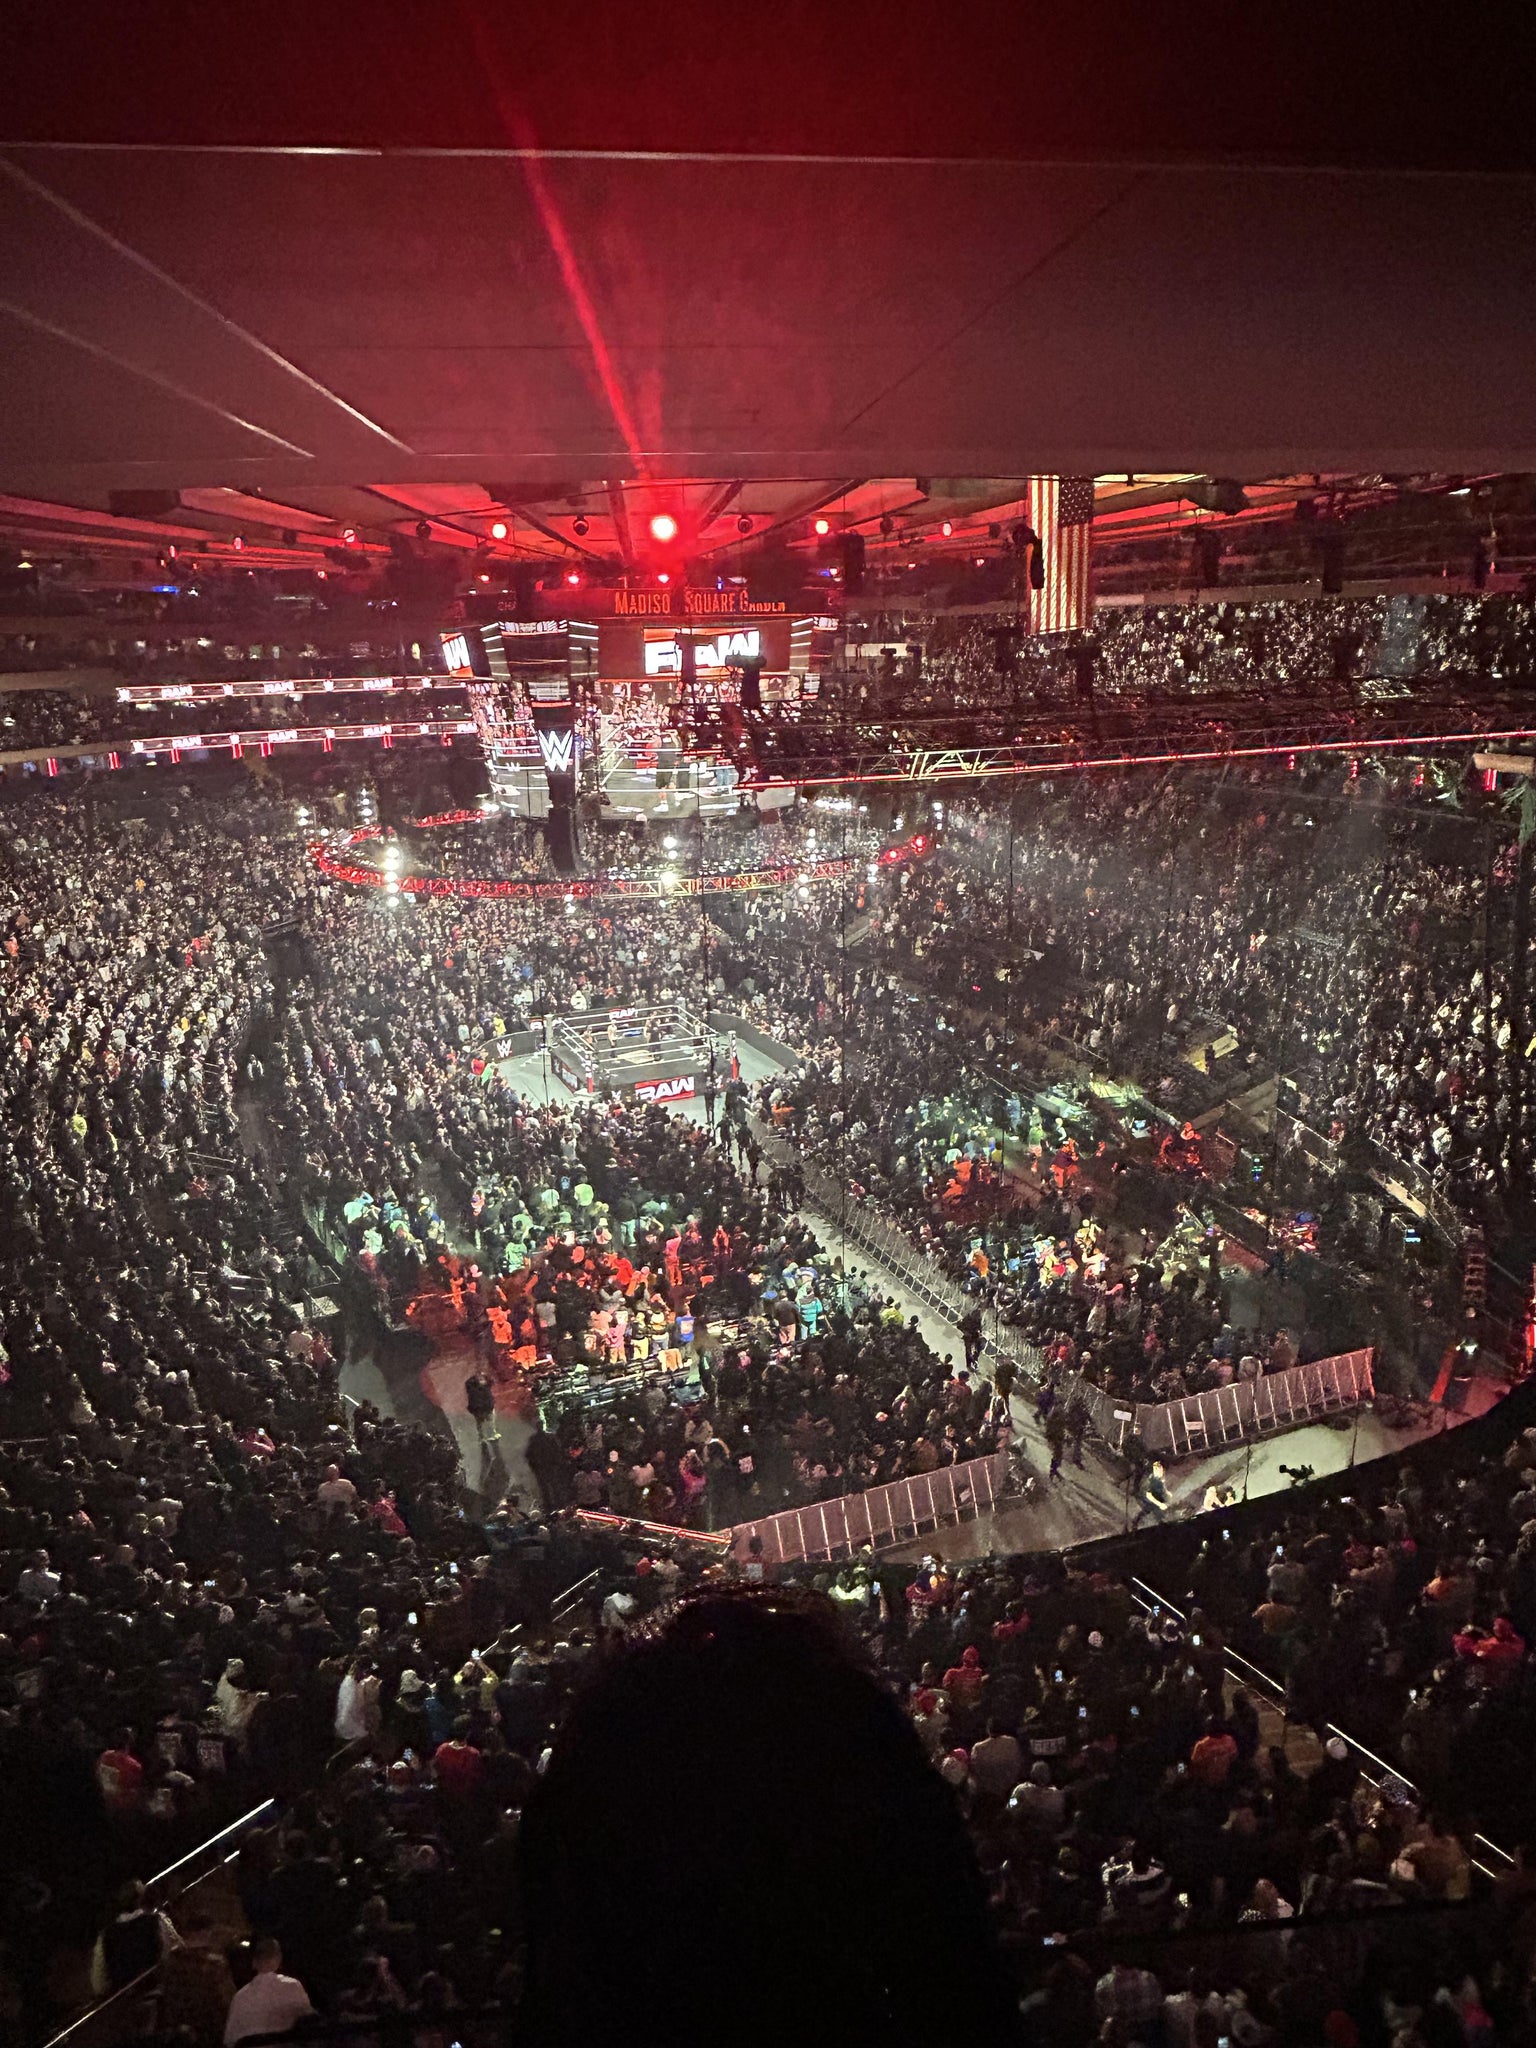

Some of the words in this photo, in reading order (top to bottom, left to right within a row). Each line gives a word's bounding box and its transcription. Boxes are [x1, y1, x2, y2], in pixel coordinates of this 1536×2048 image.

[615, 592, 671, 614] MADISO
[685, 590, 736, 613] SQUARE
[635, 1076, 695, 1102] RAW
